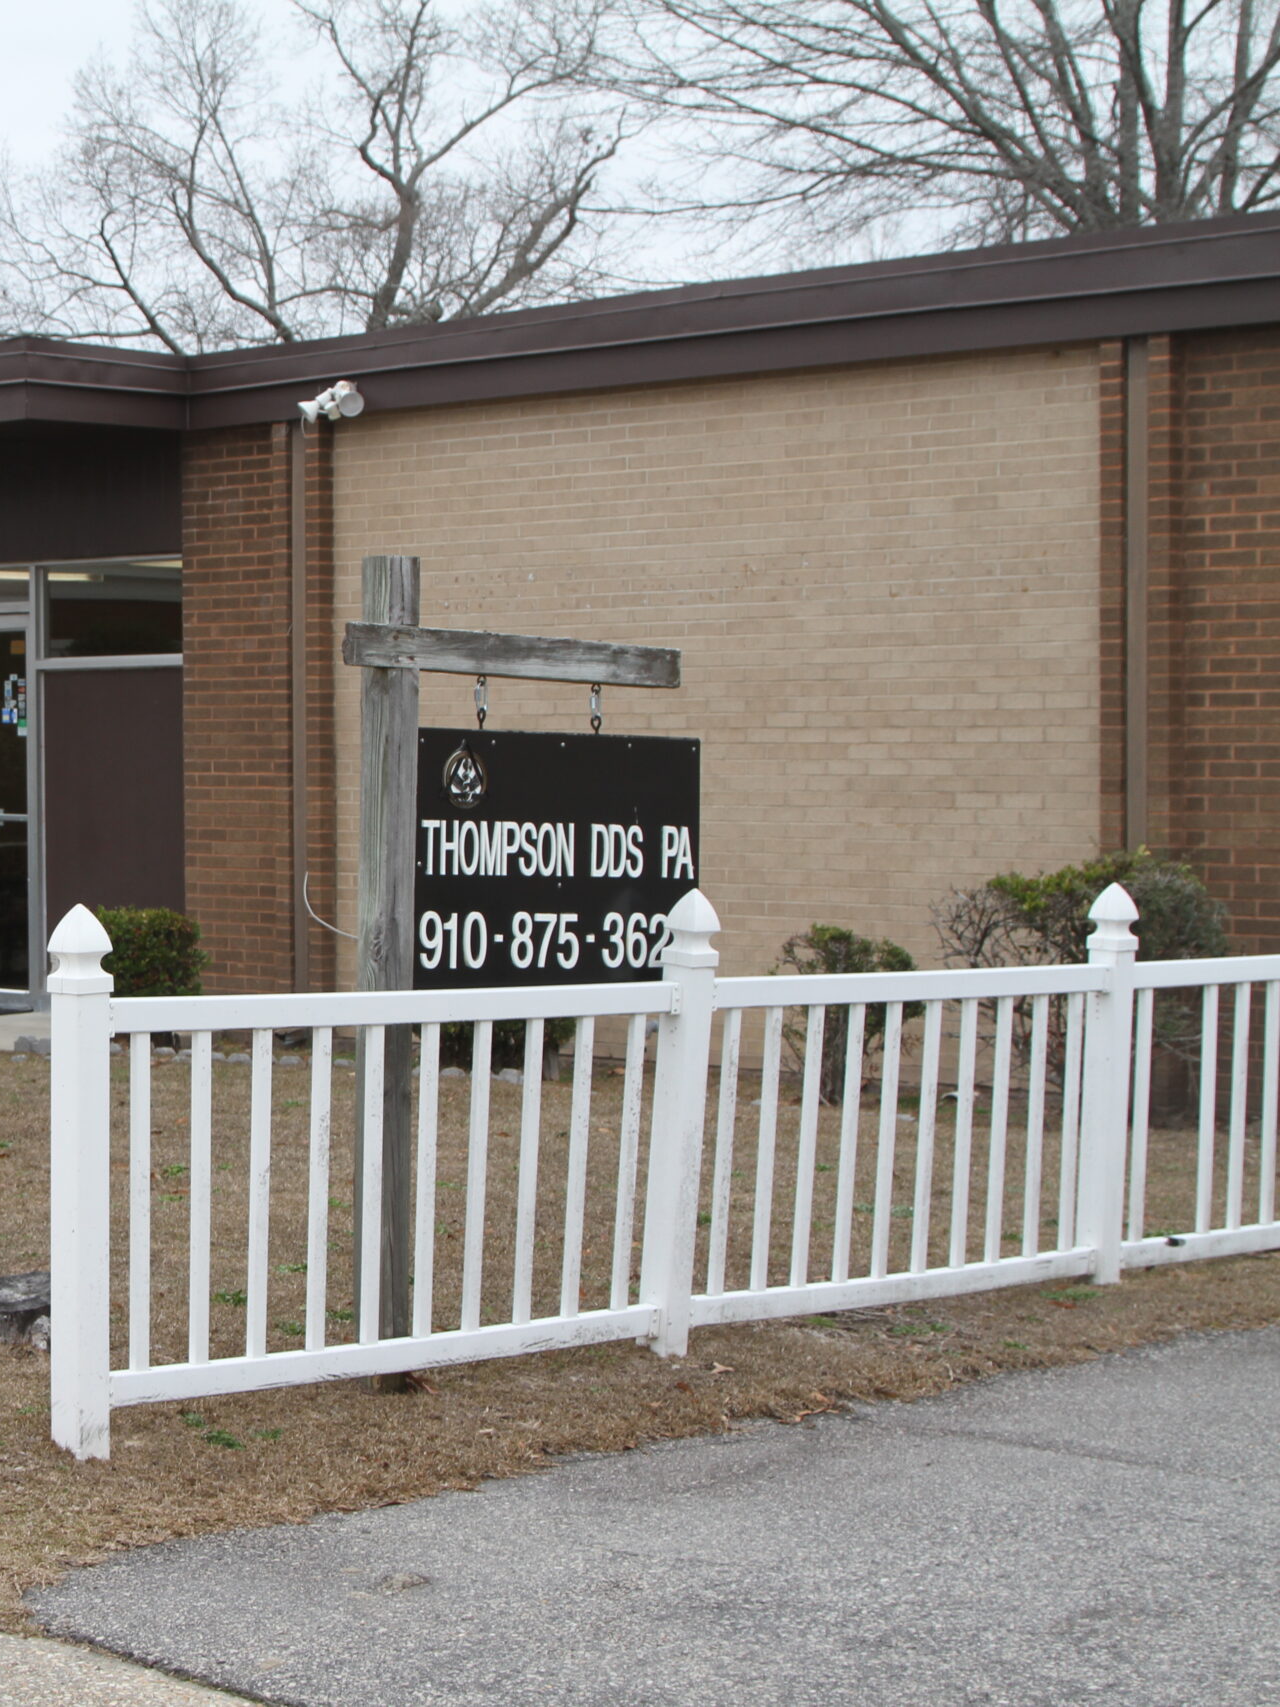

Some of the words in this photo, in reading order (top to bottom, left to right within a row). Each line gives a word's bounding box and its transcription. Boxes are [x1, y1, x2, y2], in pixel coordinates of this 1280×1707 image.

[421, 819, 575, 877] THOMPSON
[590, 823, 644, 879] DDS
[661, 825, 695, 880] PA
